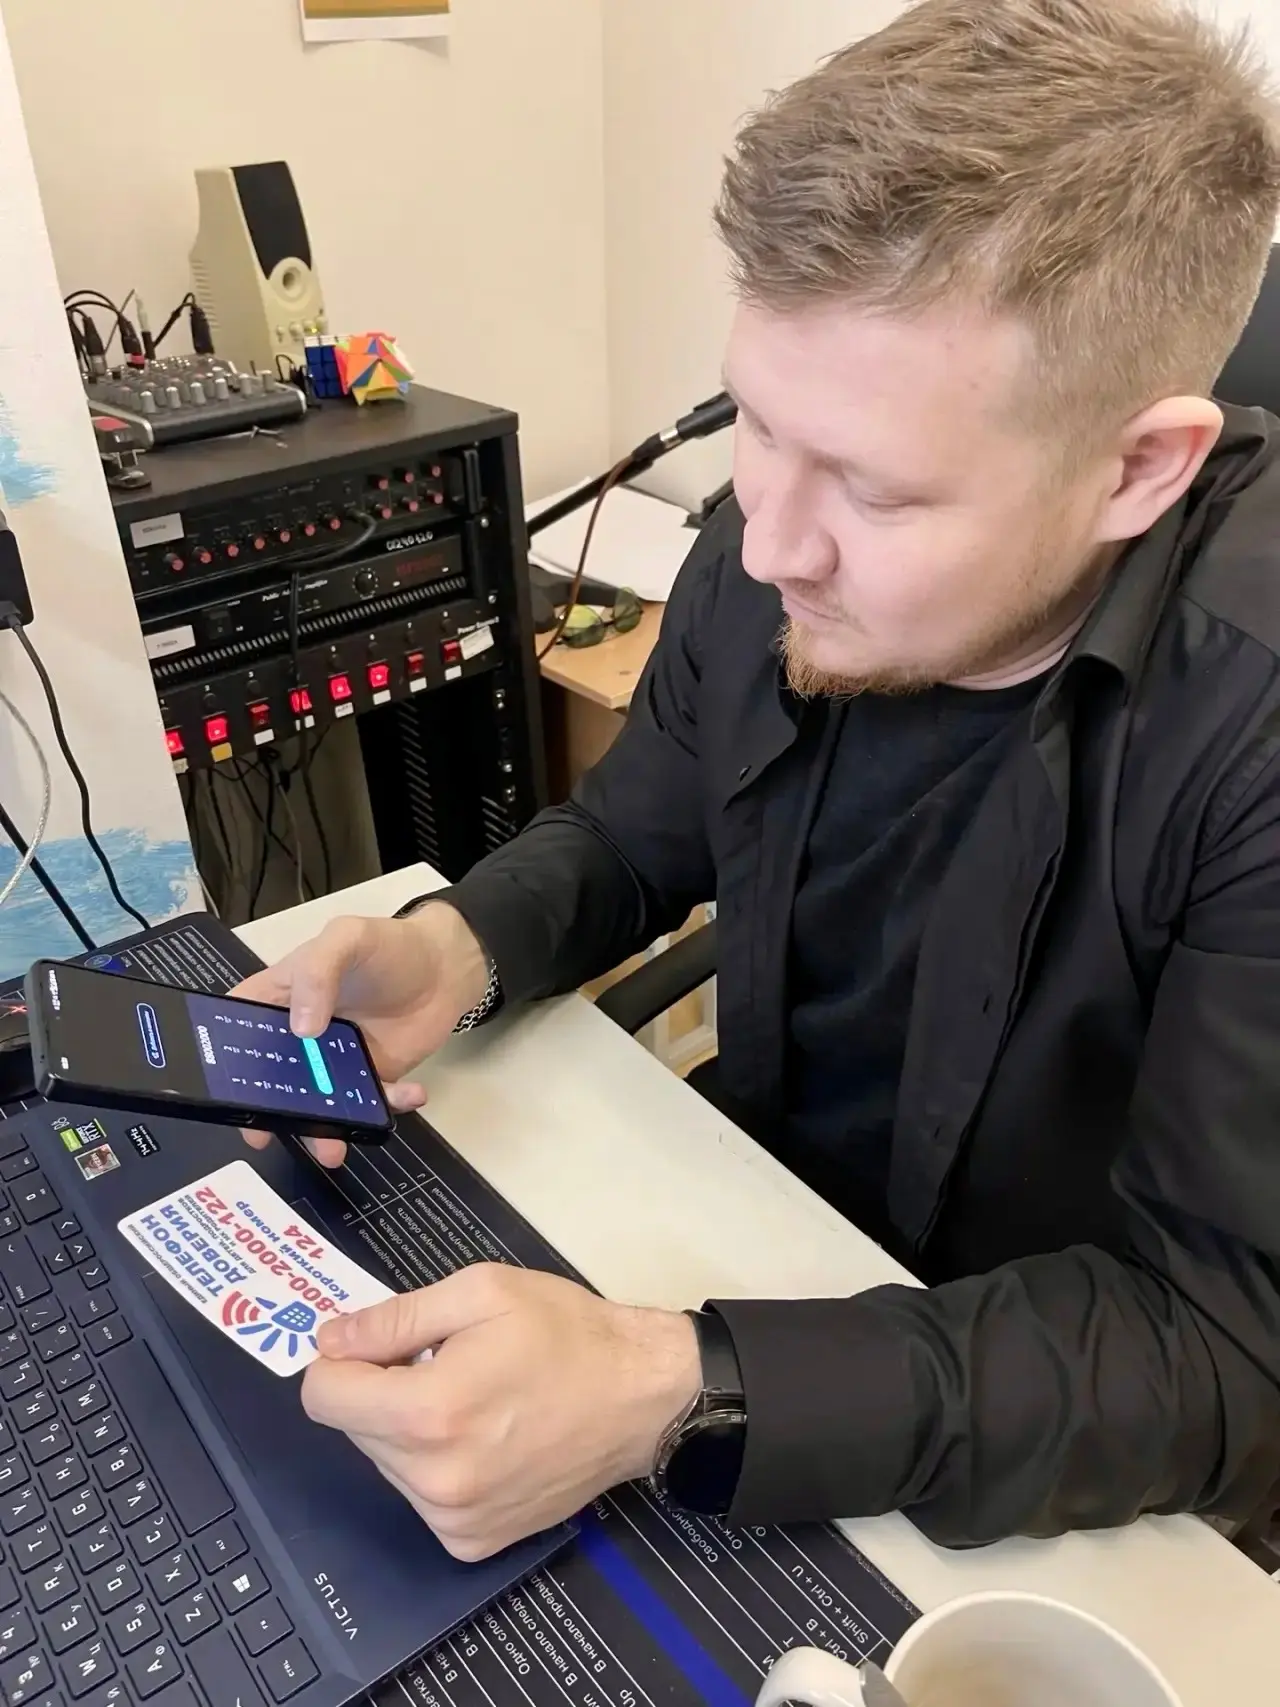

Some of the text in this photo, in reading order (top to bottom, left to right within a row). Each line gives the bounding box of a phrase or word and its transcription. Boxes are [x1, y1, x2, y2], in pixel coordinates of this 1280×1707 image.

[197, 1025, 217, 1064] 88002000
[245, 1048, 255, 1056] 5
[276, 1083, 286, 1091] 7
[81, 1121, 102, 1142] RTX
[128, 1127, 151, 1156] 144Hz
[417, 1171, 426, 1180] J
[398, 1180, 408, 1190] U
[380, 1190, 389, 1200] P
[184, 1194, 221, 1231] РОДИТЕЛЕЙ
[362, 1201, 371, 1211] E
[432, 1187, 470, 1225] выделенной
[342, 1211, 352, 1221] B
[397, 1206, 421, 1234] область
[414, 1196, 449, 1232] выделение
[177, 1197, 257, 1275] ДЛЯ ДЕТЕЙ, ПОДРОСТКОВ
[219, 1230, 231, 1241] ИХ
[378, 1217, 403, 1246] область
[159, 1203, 247, 1285] ДОВЕРИЯ
[283, 1223, 327, 1262] 124
[359, 1228, 396, 1269] выделенное
[447, 1231, 474, 1259] вернуть
[474, 1229, 501, 1258] область
[139, 1214, 224, 1297] ТЕЛЕФОН
[235, 1198, 350, 1302] Короткий номер
[126, 1224, 208, 1304] ЕДИНЫЙ ОБЩЕРОССИЙСКИЙ
[14, 1373, 26, 1384] L
[78, 1394, 92, 1406] M
[94, 1426, 108, 1438] N
[111, 1460, 124, 1471] B
[56, 1468, 70, 1480] H
[128, 1496, 141, 1506] V
[12, 1504, 26, 1515] Y
[72, 1504, 86, 1515] G
[146, 1531, 160, 1543] C
[28, 1541, 42, 1552] T
[90, 1544, 104, 1552] F
[216, 1540, 225, 1550] ALT
[166, 1568, 180, 1582] X
[44, 1577, 60, 1590] R
[312, 1570, 362, 1641] VICTUS
[791, 1563, 869, 1643] Shift + Ctrl + U
[185, 1608, 200, 1622] Z
[62, 1617, 78, 1631] E
[126, 1618, 142, 1632] S
[805, 1616, 819, 1630] B
[2, 1628, 14, 1639] 4
[561, 1616, 599, 1660] начало
[782, 1634, 797, 1647] T
[818, 1629, 828, 1639] +
[502, 1639, 533, 1675] Одно
[532, 1629, 579, 1686] В начало
[79, 1659, 96, 1676] W
[147, 1660, 162, 1672] A
[284, 1660, 294, 1676] CTRL
[593, 1658, 607, 1672] В
[19, 1670, 33, 1684] 3
